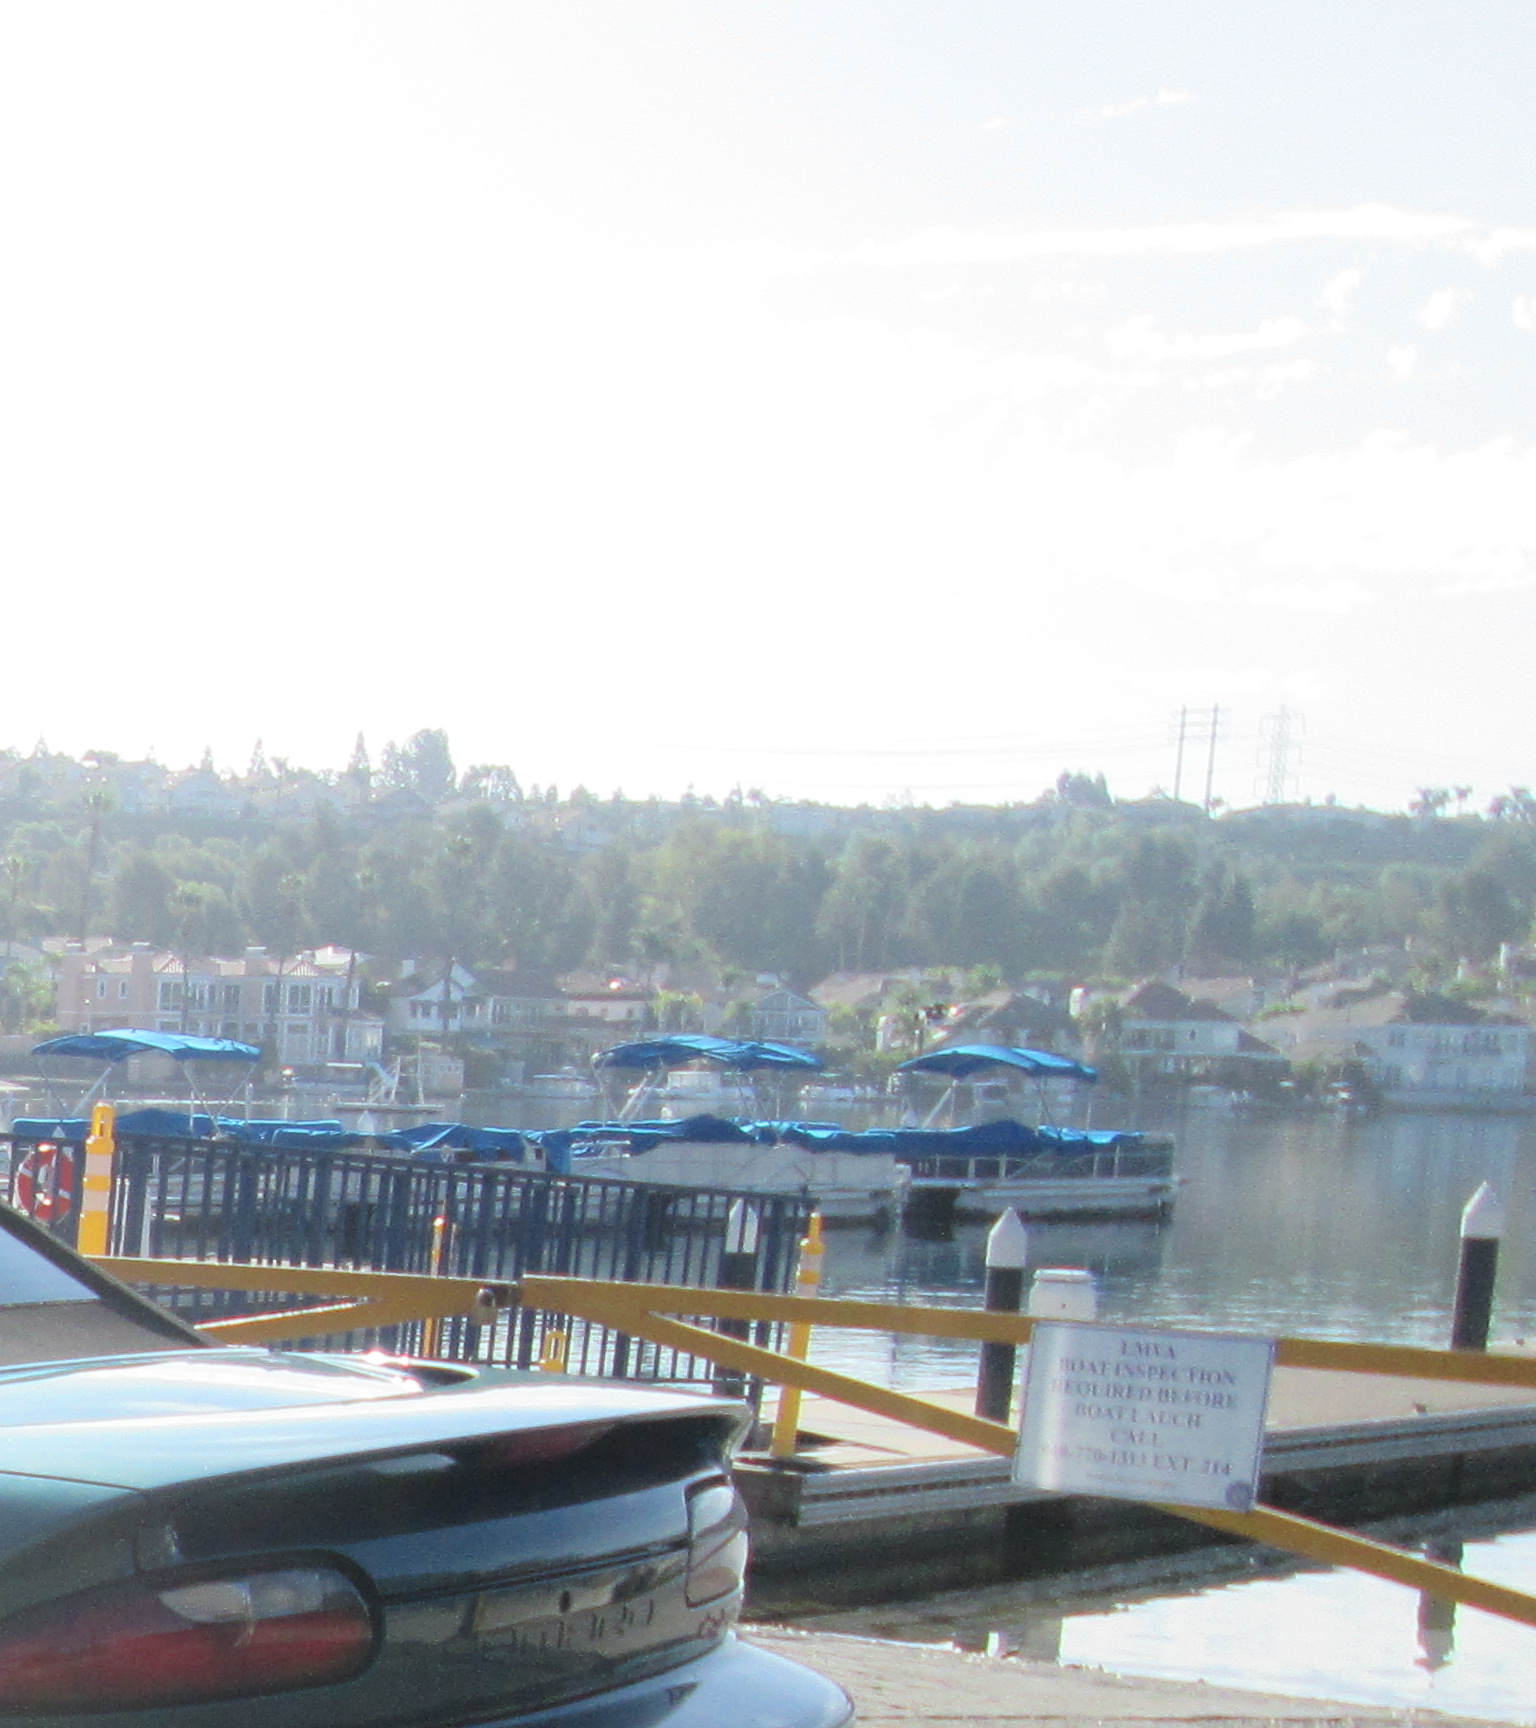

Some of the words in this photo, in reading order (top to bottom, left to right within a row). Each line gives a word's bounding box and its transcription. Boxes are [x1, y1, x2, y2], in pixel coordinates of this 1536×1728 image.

[1114, 1362, 1236, 1385] INSPECTION
[1157, 1387, 1237, 1409] BEFORE
[1076, 1402, 1127, 1420] BOAT
